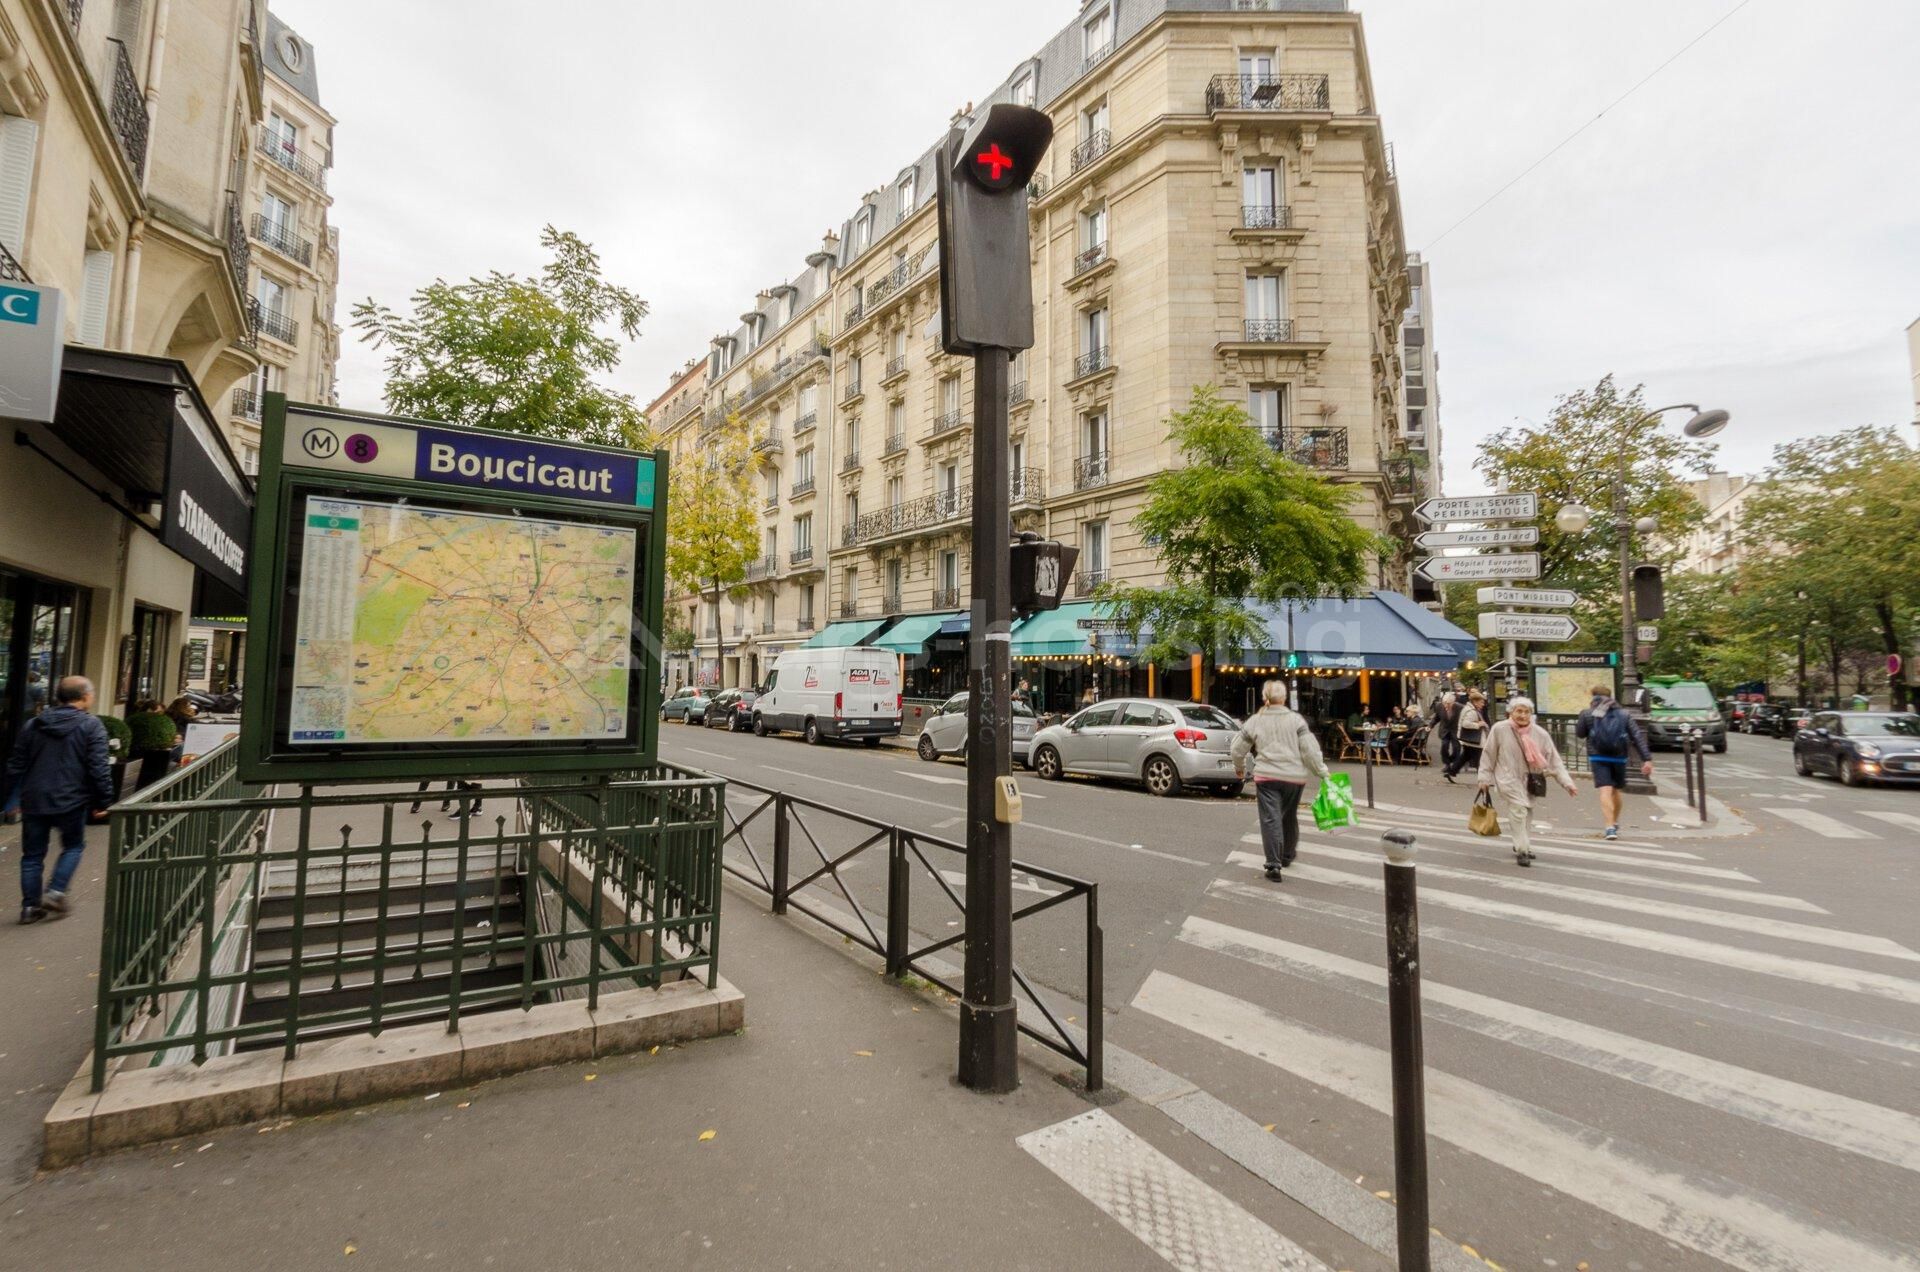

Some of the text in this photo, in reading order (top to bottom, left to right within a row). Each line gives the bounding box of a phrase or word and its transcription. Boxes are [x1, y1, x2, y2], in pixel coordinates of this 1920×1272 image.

[354, 440, 368, 458] 8
[429, 443, 613, 494] Boucicaut
[1437, 500, 1470, 509] PORTE
[1487, 497, 1529, 507] SEVRES
[1433, 506, 1529, 519] PERIPHERIQUE
[178, 489, 244, 576] STARBUCKS COFFEE
[1457, 532, 1531, 542] Place Balard
[1453, 558, 1528, 568] Hôpital Européen
[1453, 567, 1532, 577] Georges POMPIDOU
[1496, 592, 1566, 602] PONT MIRABEAU
[1499, 617, 1520, 626] Centre
[1499, 626, 1509, 635] LA
[1559, 655, 1606, 664] Boucicaut
